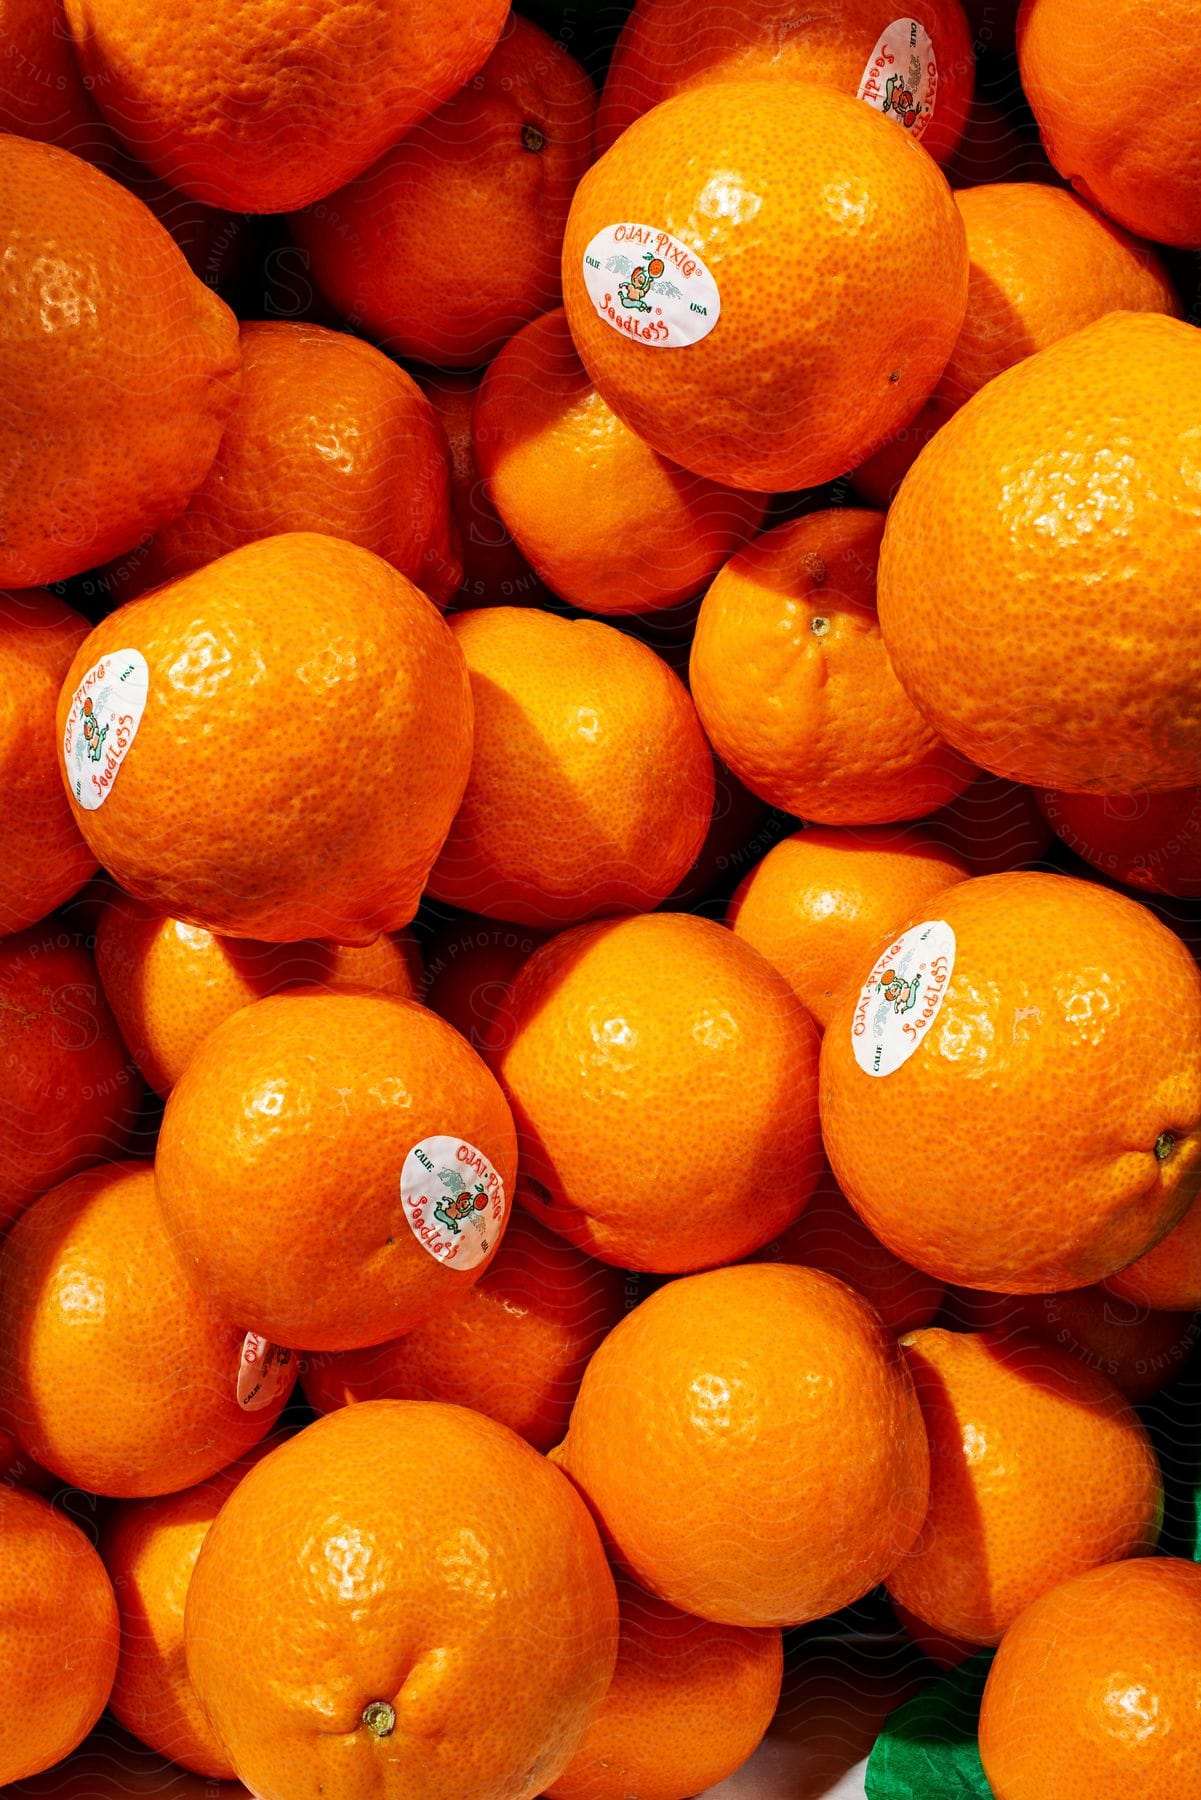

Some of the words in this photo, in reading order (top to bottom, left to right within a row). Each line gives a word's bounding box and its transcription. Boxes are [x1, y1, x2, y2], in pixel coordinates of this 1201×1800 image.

[613, 225, 651, 244] OJAI
[689, 302, 708, 317] USA
[119, 664, 135, 683] USA
[853, 995, 871, 1037] OJAI
[414, 1148, 435, 1173] CALIF.
[455, 1145, 487, 1176] OJAI
[245, 1333, 261, 1366] OJA
